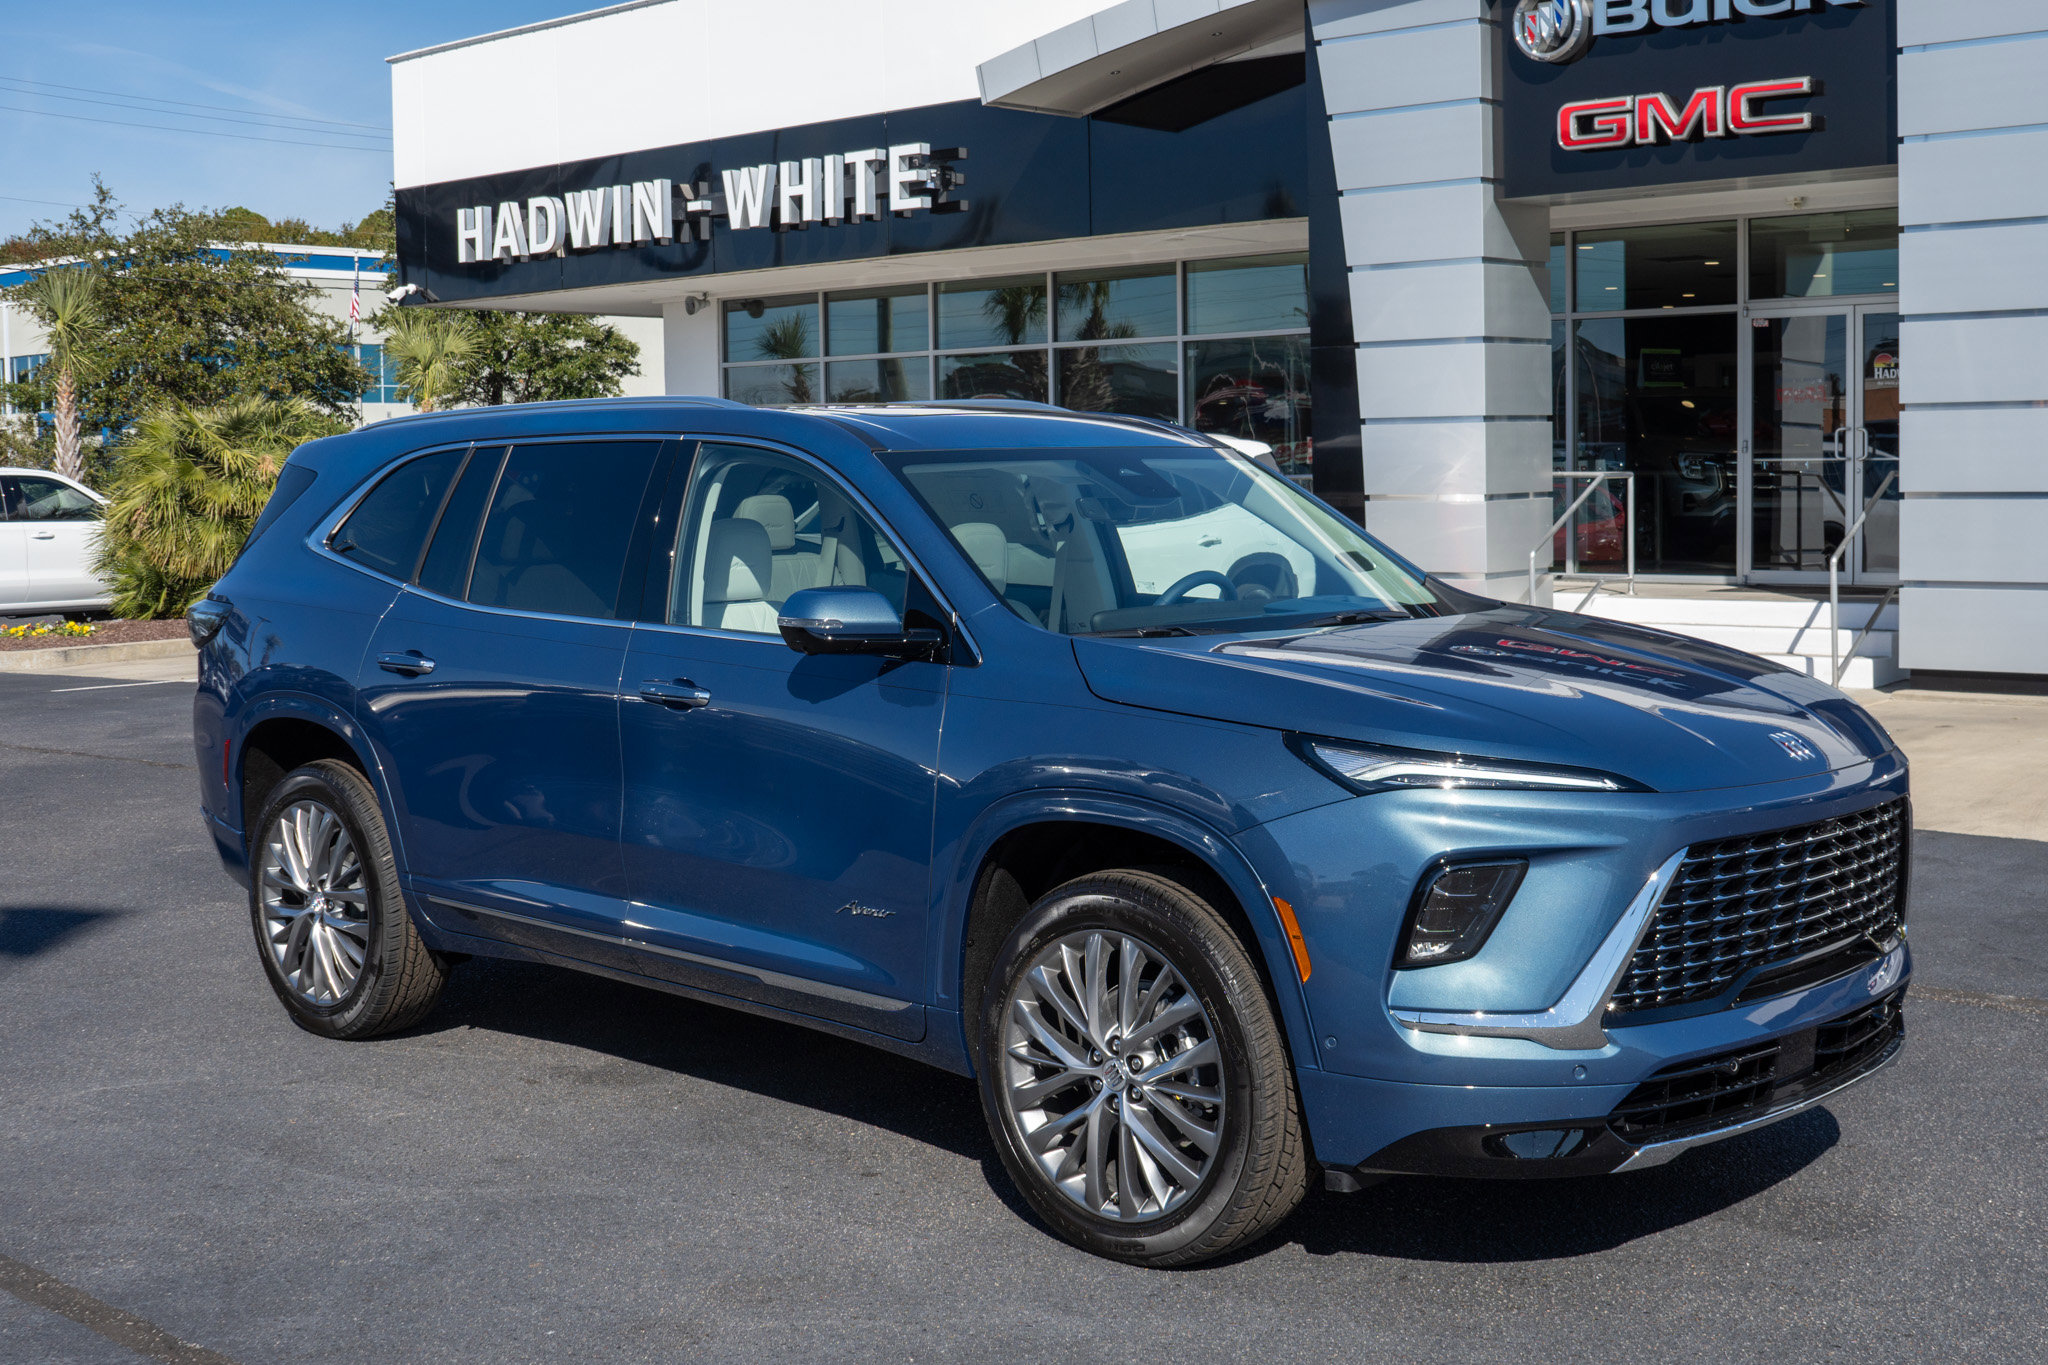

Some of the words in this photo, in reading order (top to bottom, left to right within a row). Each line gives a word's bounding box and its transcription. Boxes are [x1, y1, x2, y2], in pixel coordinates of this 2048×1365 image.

[1557, 76, 1811, 151] GMC
[457, 178, 672, 263] HADWIN
[722, 142, 931, 230] WHITE
